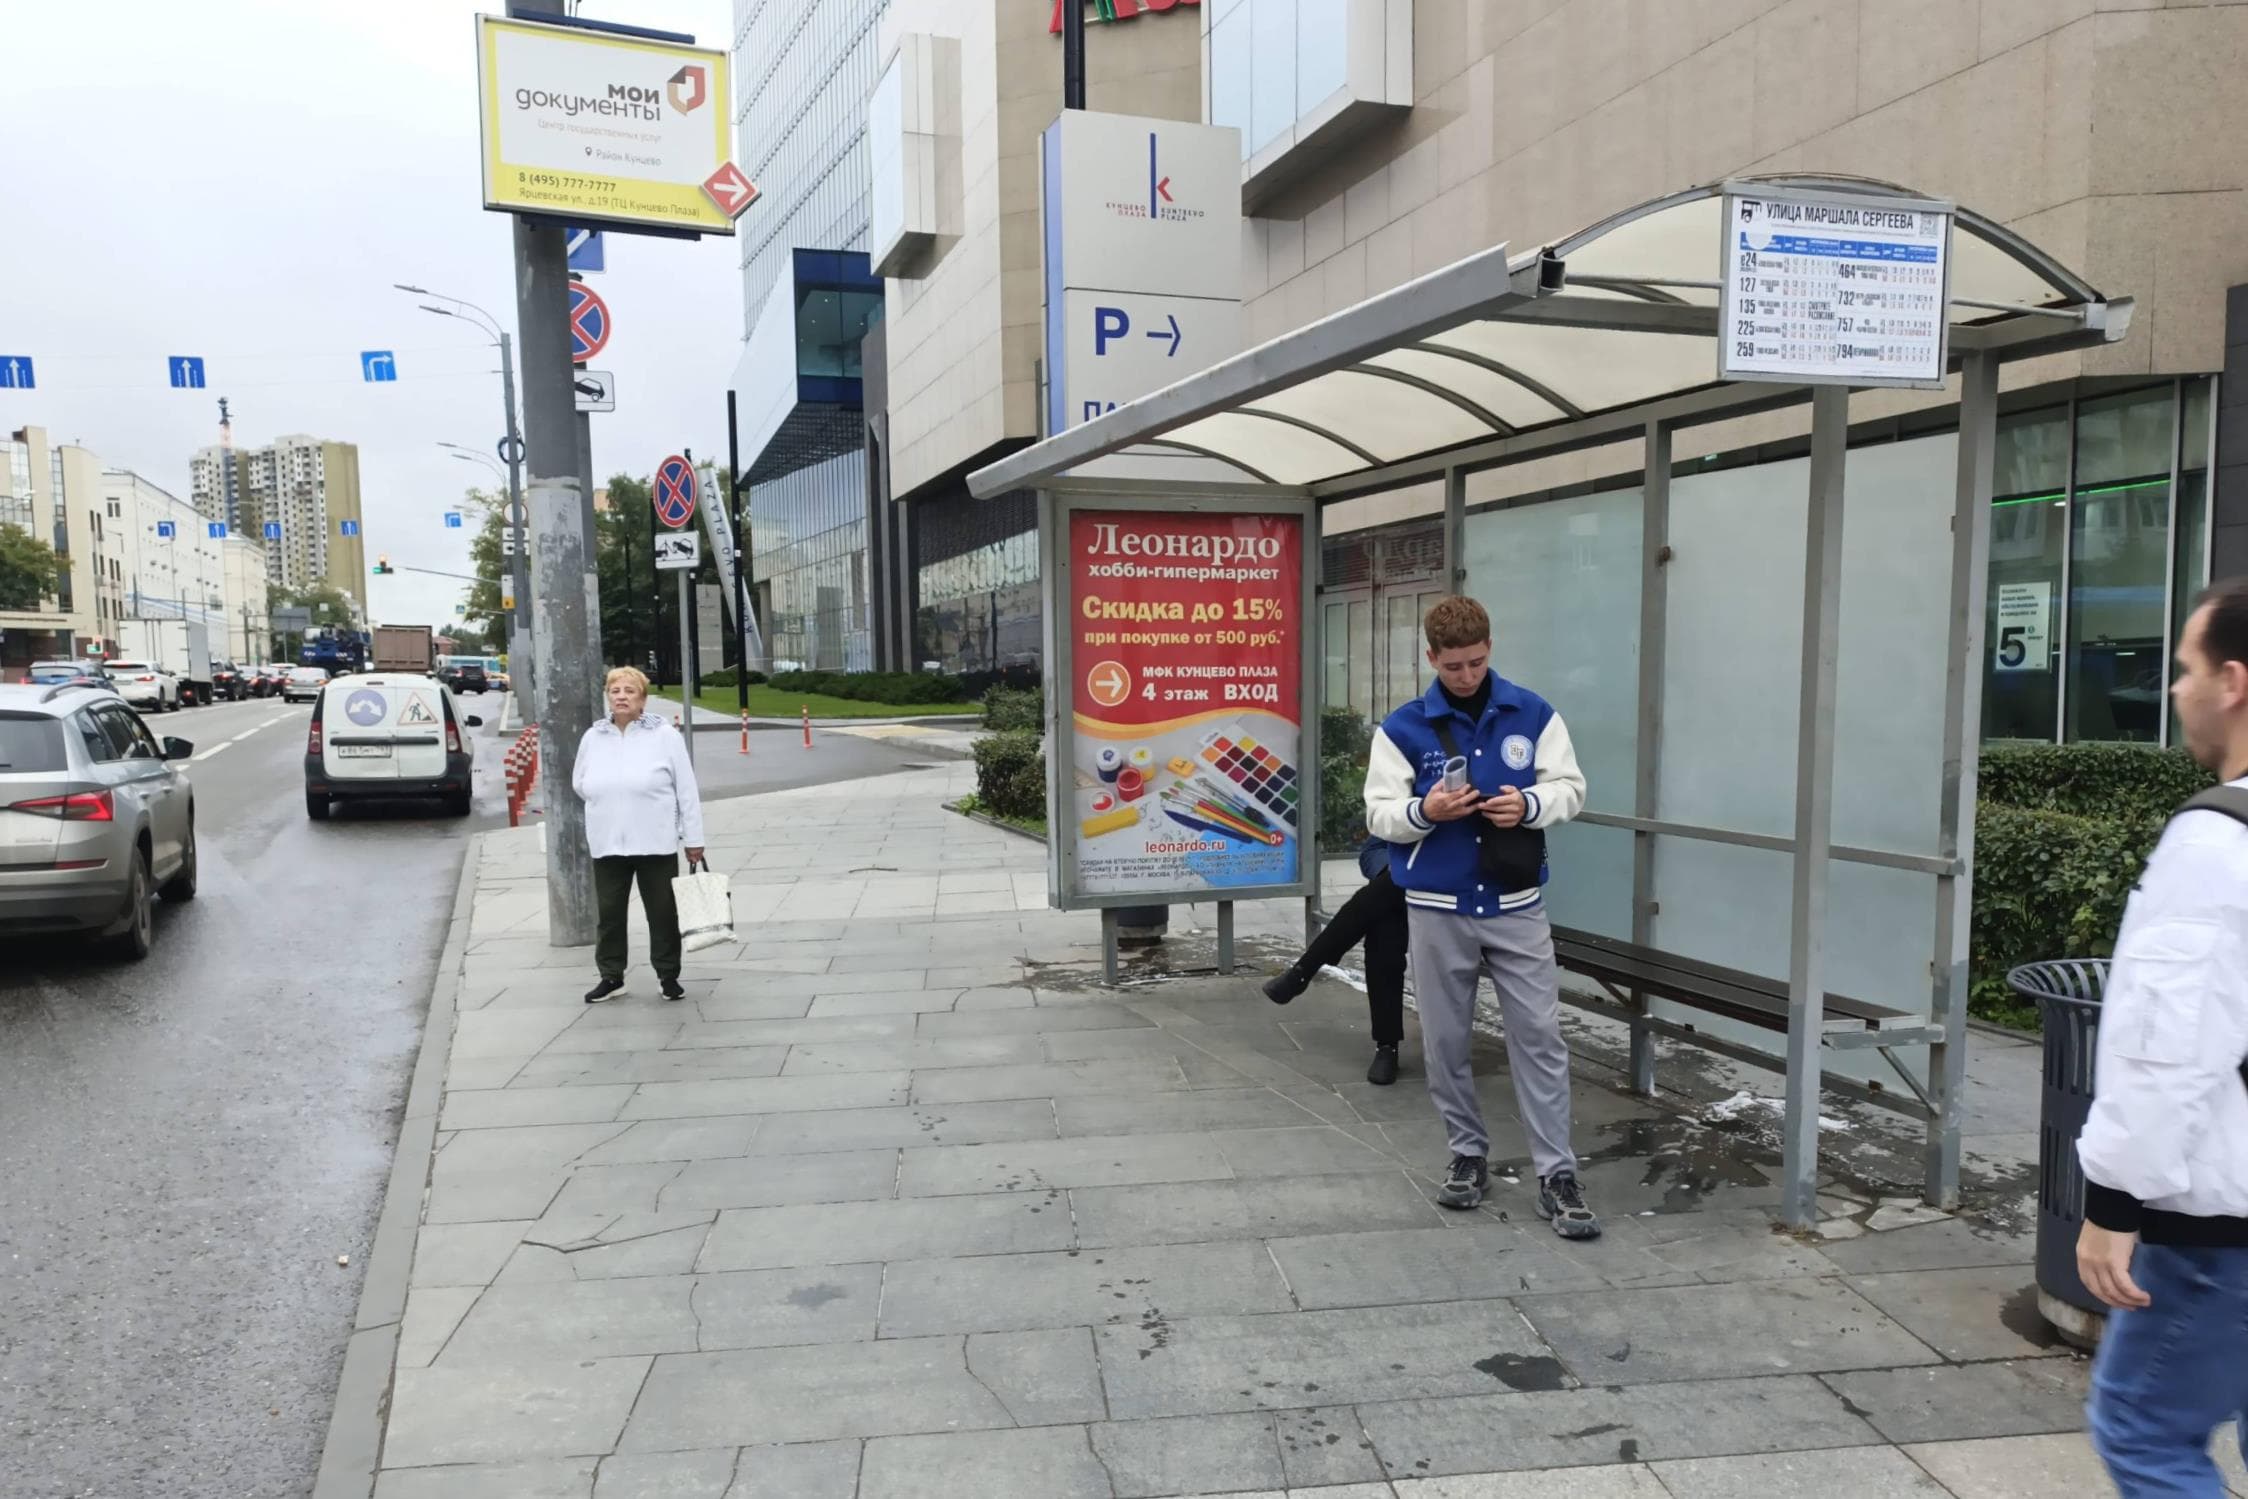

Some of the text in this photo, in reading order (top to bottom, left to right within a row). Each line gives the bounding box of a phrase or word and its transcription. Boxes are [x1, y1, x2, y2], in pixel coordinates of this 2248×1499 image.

[516, 88, 661, 121] документы
[596, 149, 662, 166] Район Кунцево
[518, 172, 617, 192] 8 (495) 777-7777
[519, 187, 569, 202] Ярцевская
[611, 197, 627, 210] (ТЦ
[629, 199, 668, 214] Кунцево
[670, 203, 700, 218] Плаза)
[1766, 202, 1914, 229] УЛИЦА МАРШАЛА СЕРГЕЕВА
[1839, 263, 1856, 279] 464
[1740, 277, 1756, 293] 127
[1739, 298, 1756, 314] 135
[1838, 290, 1855, 306] 732
[1095, 307, 1130, 356] P
[1737, 319, 1755, 336] 225
[1837, 317, 1854, 333] 757
[1737, 341, 1754, 357] 259
[1836, 343, 1853, 359] 794
[704, 480, 726, 535] PLAZA
[1087, 523, 1281, 566] Леонардо
[1088, 563, 1279, 583] хобби-гипермаркет
[1082, 595, 1283, 624] Скидка до 15%
[1084, 631, 1117, 647] при
[1121, 632, 1190, 647] покупке
[1194, 633, 1212, 645] от
[1216, 631, 1247, 645] 500
[2000, 626, 2026, 667] 5
[1143, 666, 1278, 679] МФК КУНЦЕВО ПЛАЗА
[1142, 683, 1279, 702] 4 этаж ВХОД
[1145, 840, 1226, 854] leonardo.ru
[1270, 834, 1283, 845] 0+
